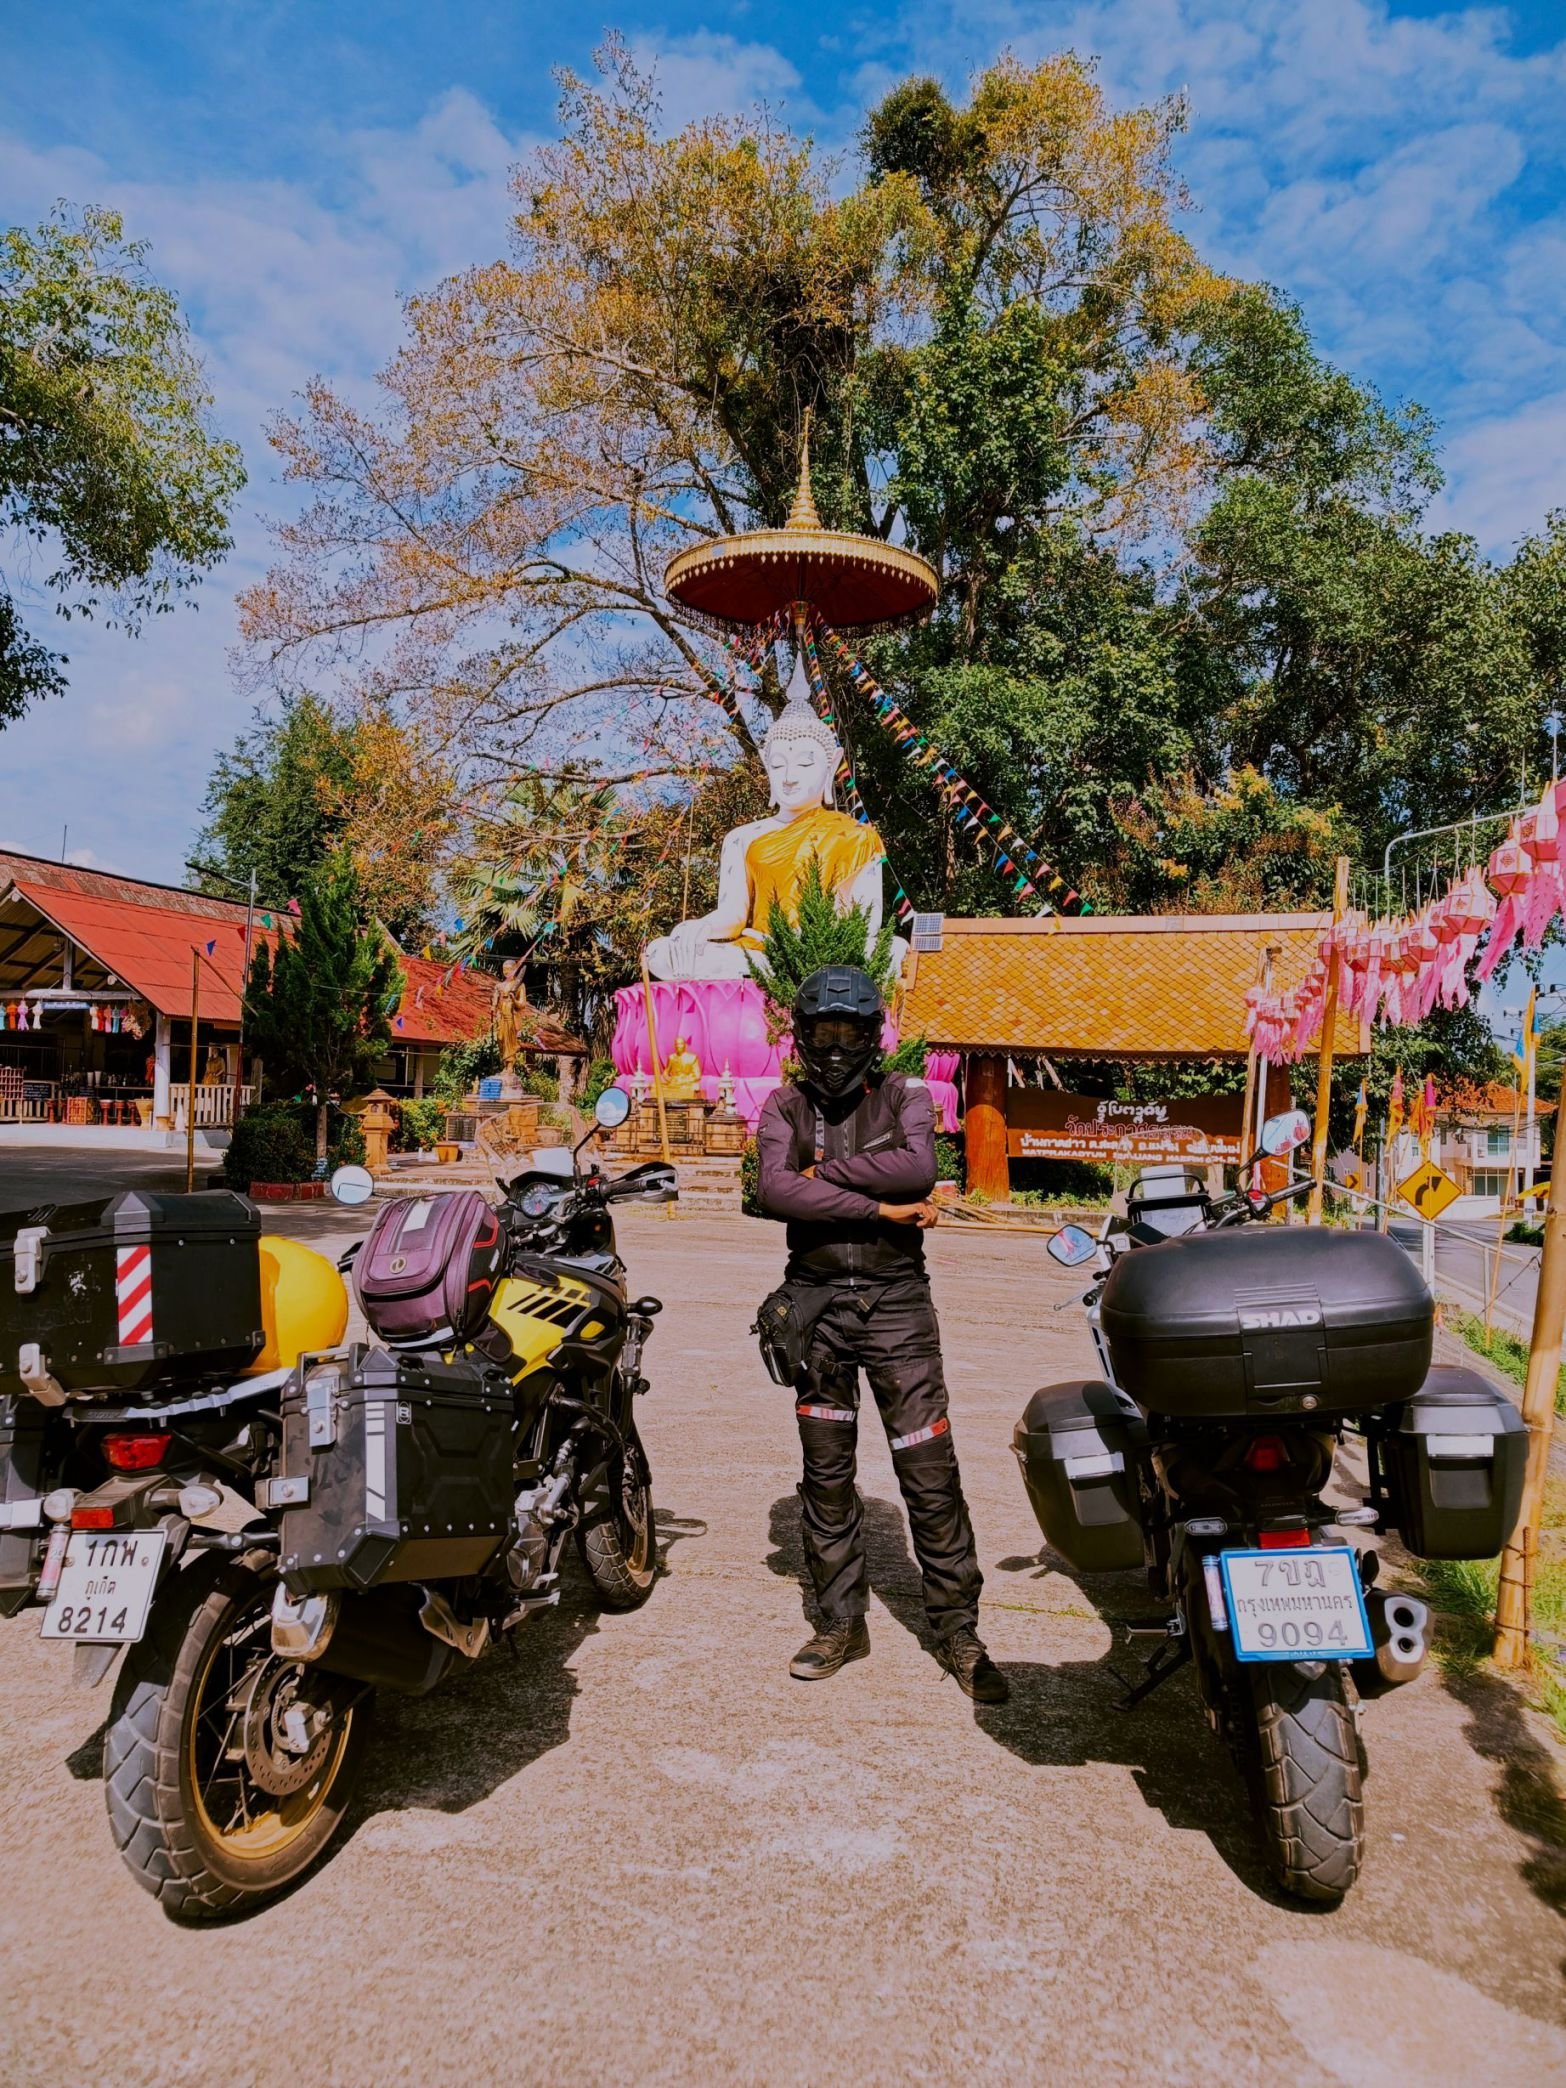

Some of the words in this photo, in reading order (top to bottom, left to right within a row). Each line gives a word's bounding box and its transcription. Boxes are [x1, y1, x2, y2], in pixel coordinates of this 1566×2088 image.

[1242, 1310, 1320, 1329] SHAD
[85, 1575, 117, 1600] ภูเก็ต
[1236, 1594, 1353, 1618] กรุงเทพมหานคร
[58, 1606, 128, 1634] 8214
[1257, 1619, 1348, 1648] 9094
